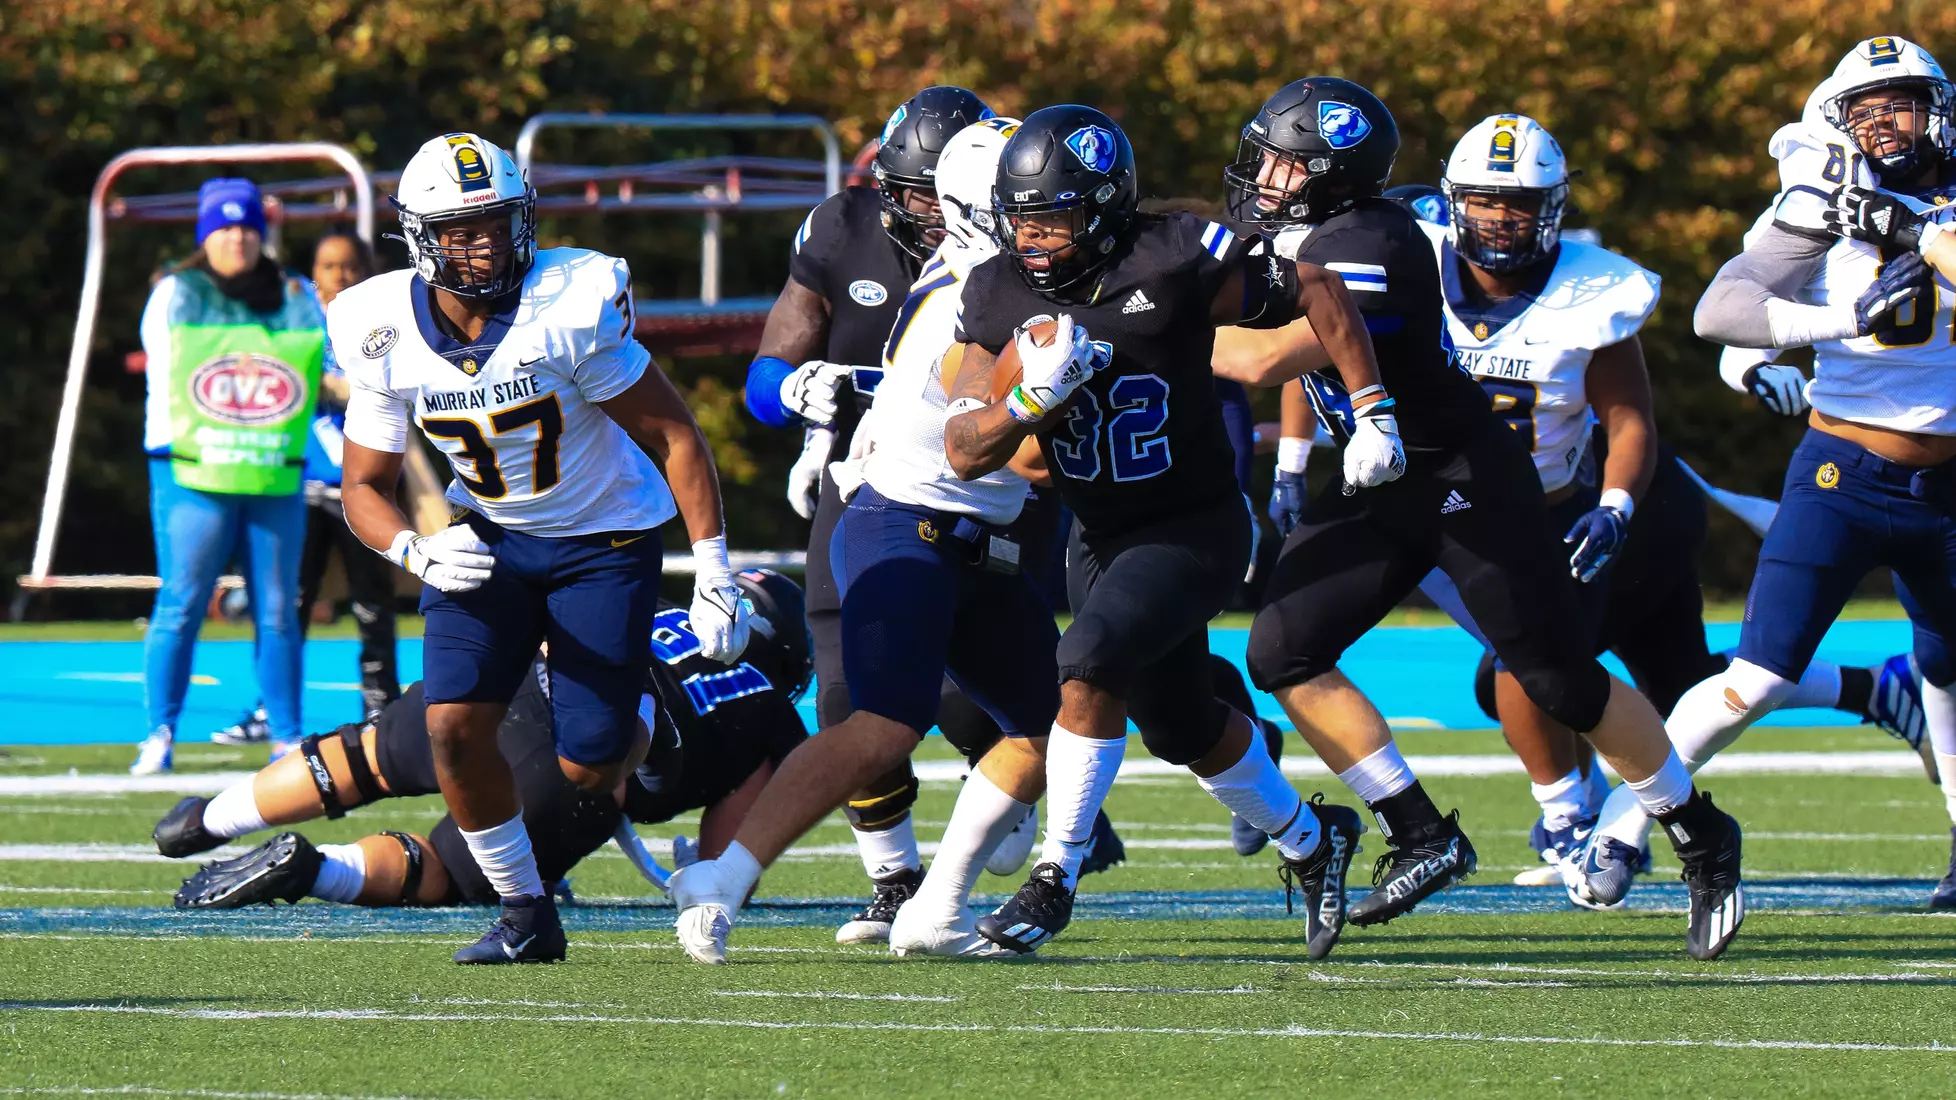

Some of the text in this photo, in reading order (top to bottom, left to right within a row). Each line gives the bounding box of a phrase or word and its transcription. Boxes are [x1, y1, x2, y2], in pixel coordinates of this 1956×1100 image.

[1014, 191, 1029, 202] EIU
[1122, 302, 1156, 314] adidas
[1487, 356, 1531, 379] STATE
[209, 371, 280, 406] OVC
[423, 374, 541, 412] MURRAY STATE
[1052, 373, 1172, 482] 32
[420, 390, 565, 501] 37
[1441, 501, 1472, 514] adidas
